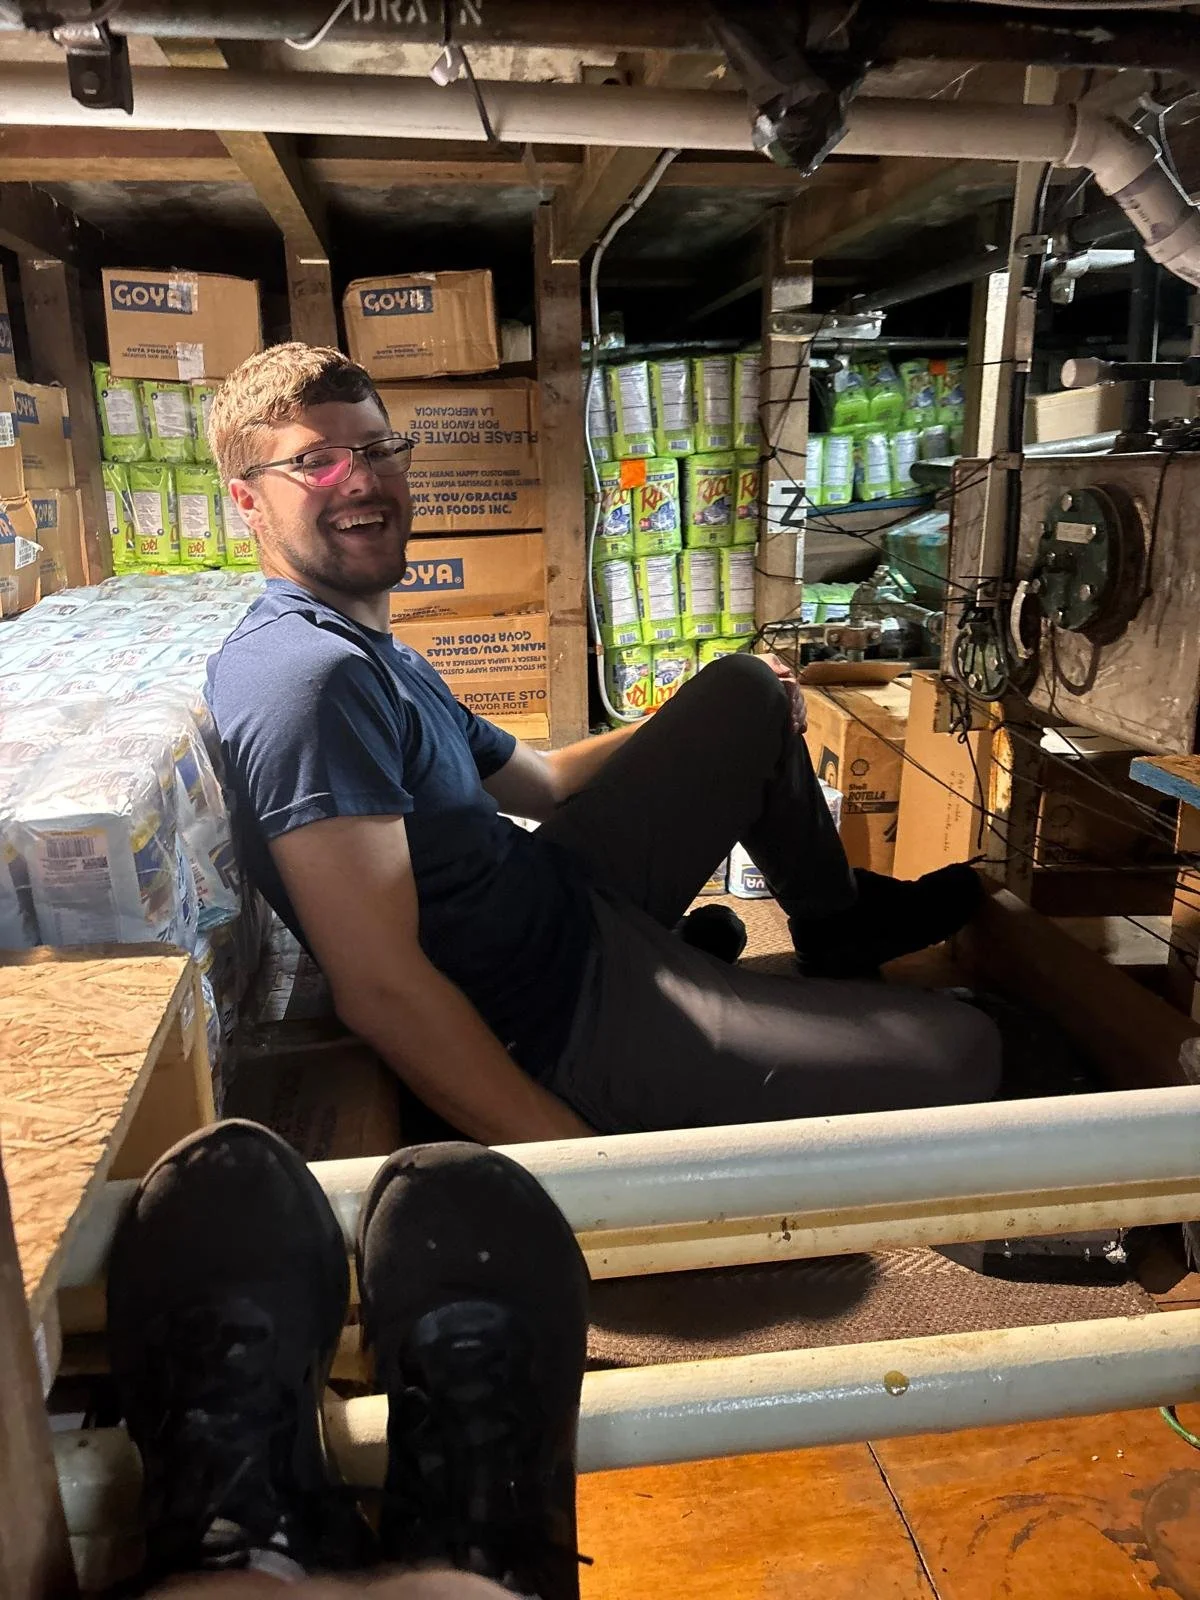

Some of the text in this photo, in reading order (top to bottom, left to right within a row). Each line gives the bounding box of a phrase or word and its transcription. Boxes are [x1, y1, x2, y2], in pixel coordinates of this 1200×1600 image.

[114, 285, 182, 308] GOYA
[364, 290, 425, 312] GOYA
[415, 407, 494, 416] LA MERCANCIA
[410, 420, 500, 429] POR FAVOR ROTE
[425, 431, 480, 444] ROTATE
[484, 431, 538, 444] PLEASE
[434, 492, 518, 502] YOU/GRACIAS
[447, 505, 485, 515] FOODS
[489, 504, 512, 514] INC.
[399, 563, 453, 586] OYA
[432, 631, 531, 646] GOYA FOODS INC.
[427, 642, 546, 657] HANK YOU/GRACIAS
[464, 691, 516, 703] ROTATE
[519, 690, 547, 700] STO
[469, 701, 529, 711] FAVOR ROTE
[847, 790, 886, 800] ROTELLA
